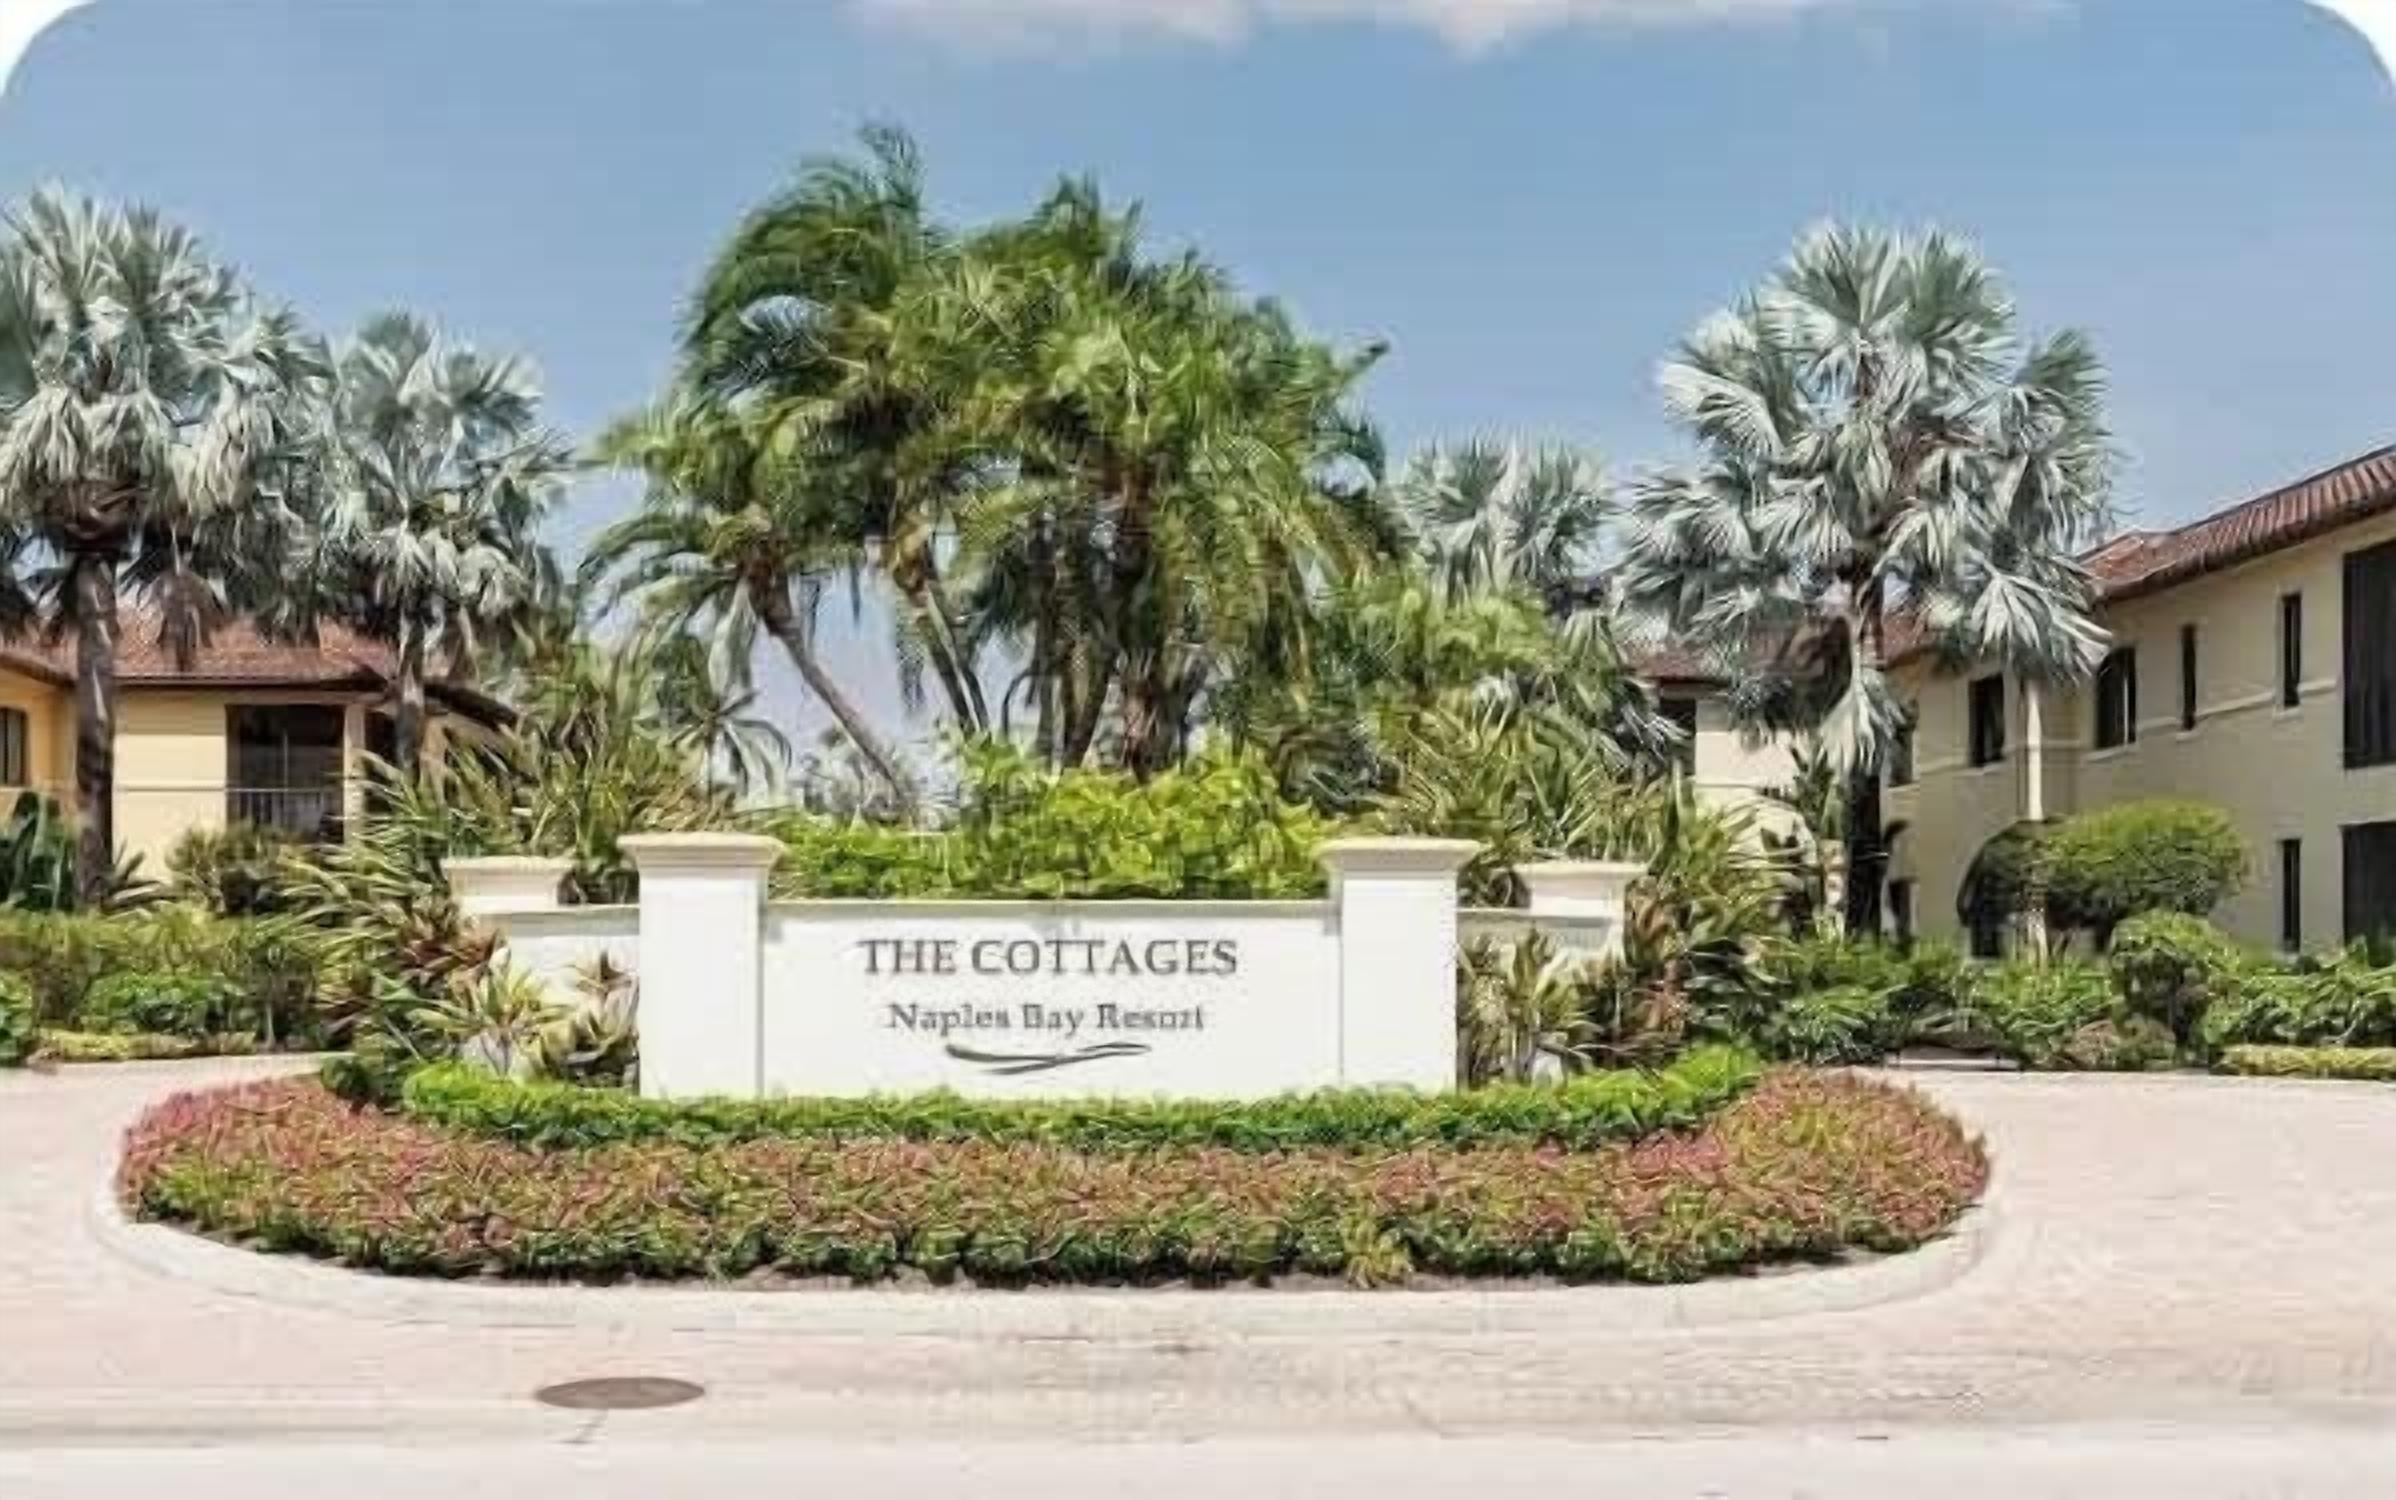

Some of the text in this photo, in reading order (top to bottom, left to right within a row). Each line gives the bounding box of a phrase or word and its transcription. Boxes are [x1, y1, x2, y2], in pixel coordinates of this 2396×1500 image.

[860, 938, 1238, 976] THE COTTAGES
[888, 1003, 1204, 1036] Naples Bay Resort
